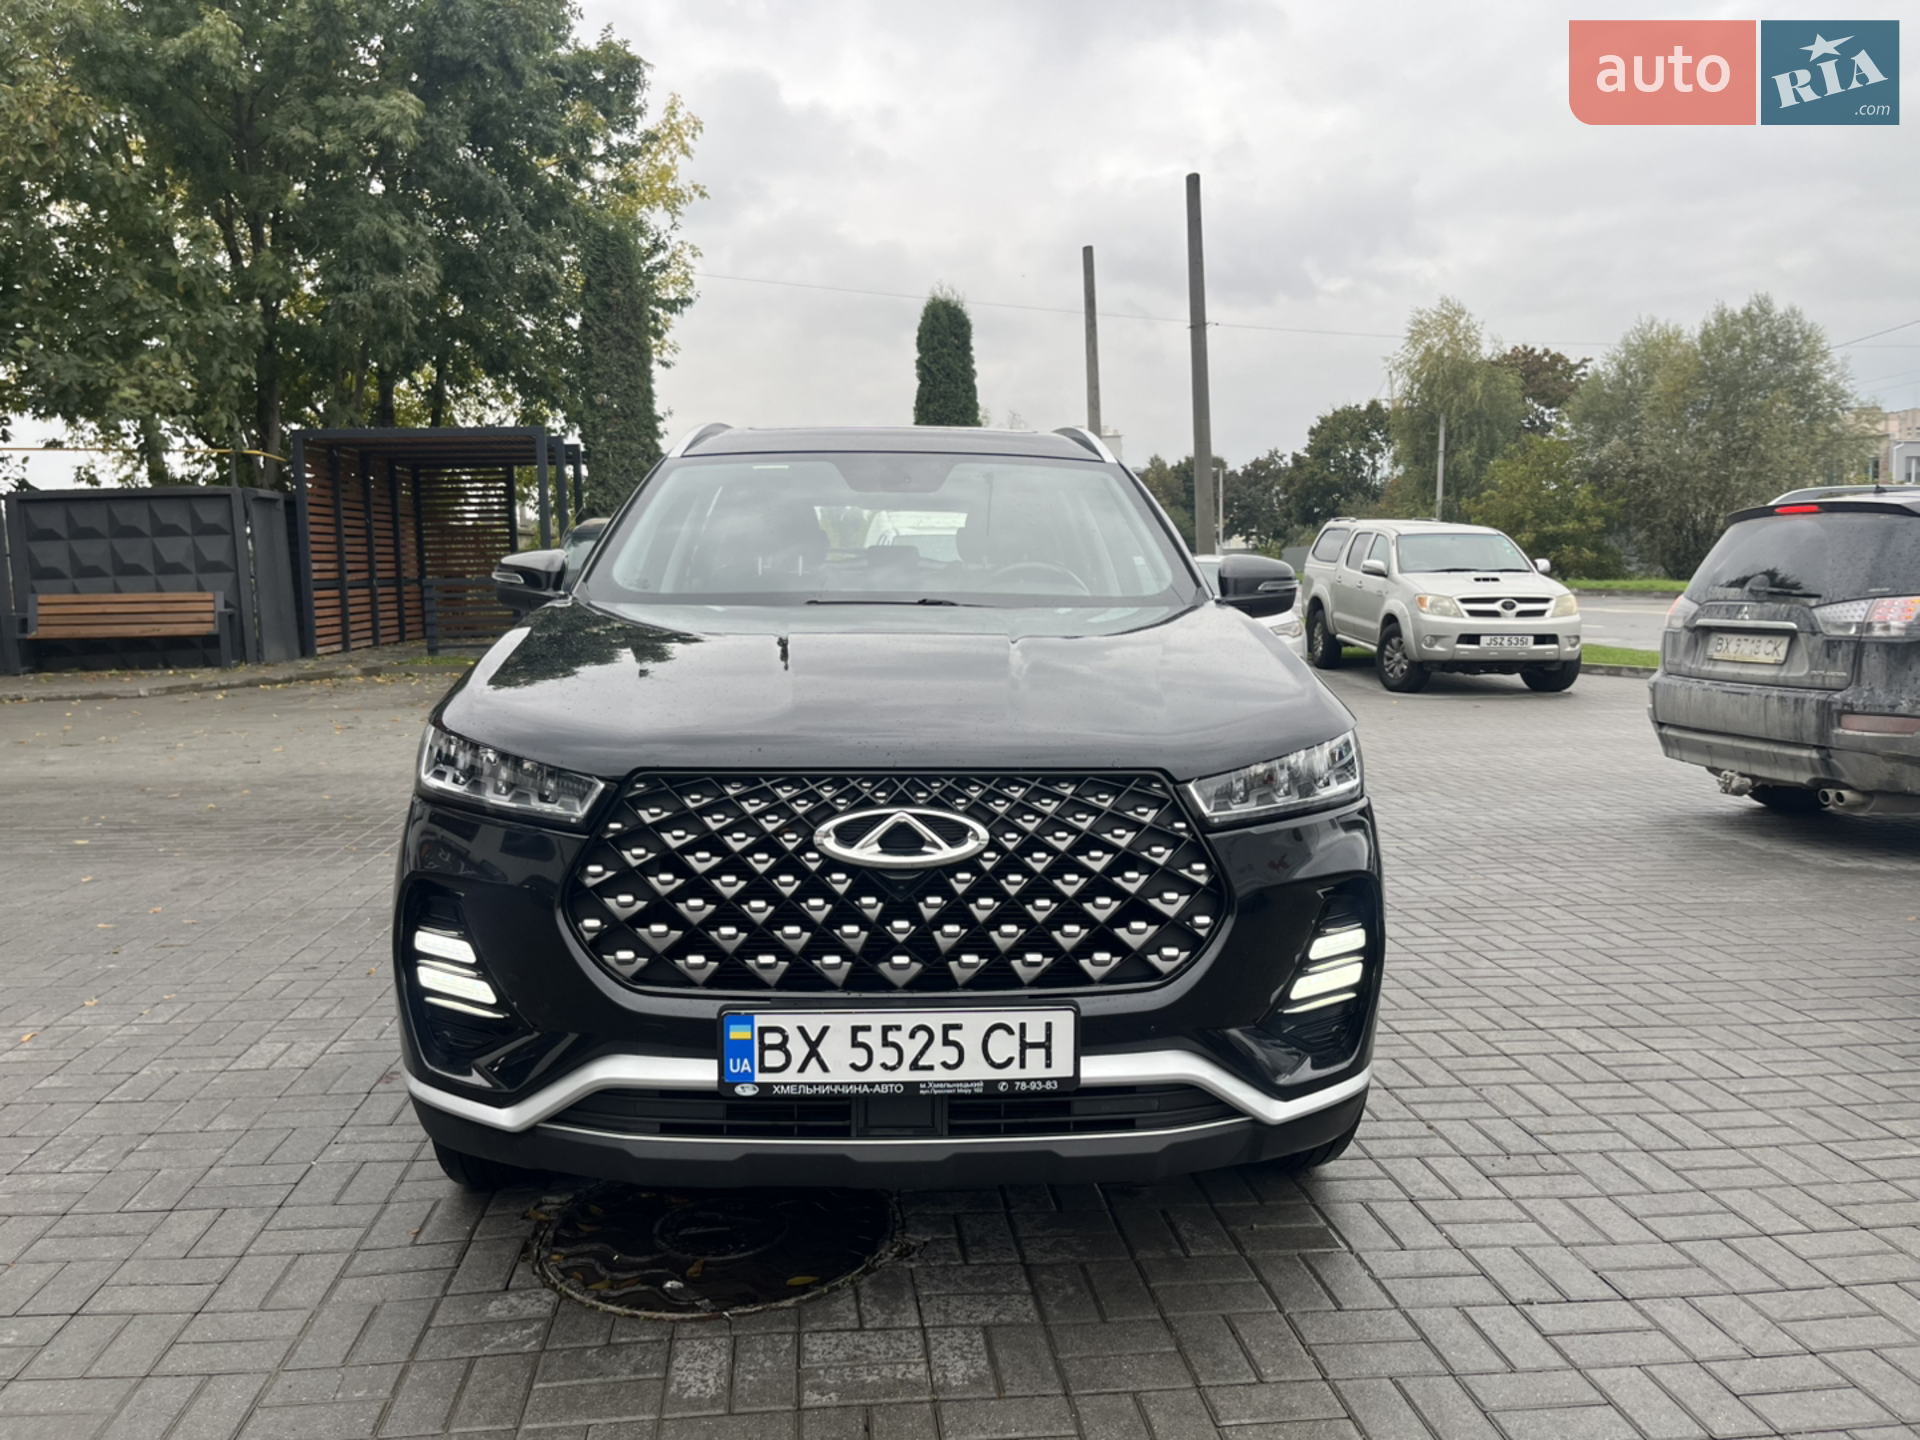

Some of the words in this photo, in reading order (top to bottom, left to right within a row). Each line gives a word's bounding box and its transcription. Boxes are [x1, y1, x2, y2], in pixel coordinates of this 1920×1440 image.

[1486, 636, 1505, 646] JSZ
[757, 1025, 831, 1074] BX
[849, 1023, 965, 1072] 5525
[981, 1021, 1053, 1070] CH
[729, 1058, 752, 1073] UA
[772, 1083, 904, 1095] ХМЕЛЬНИЧЧИНА-АВТО
[1014, 1080, 1058, 1091] 78-93-83
